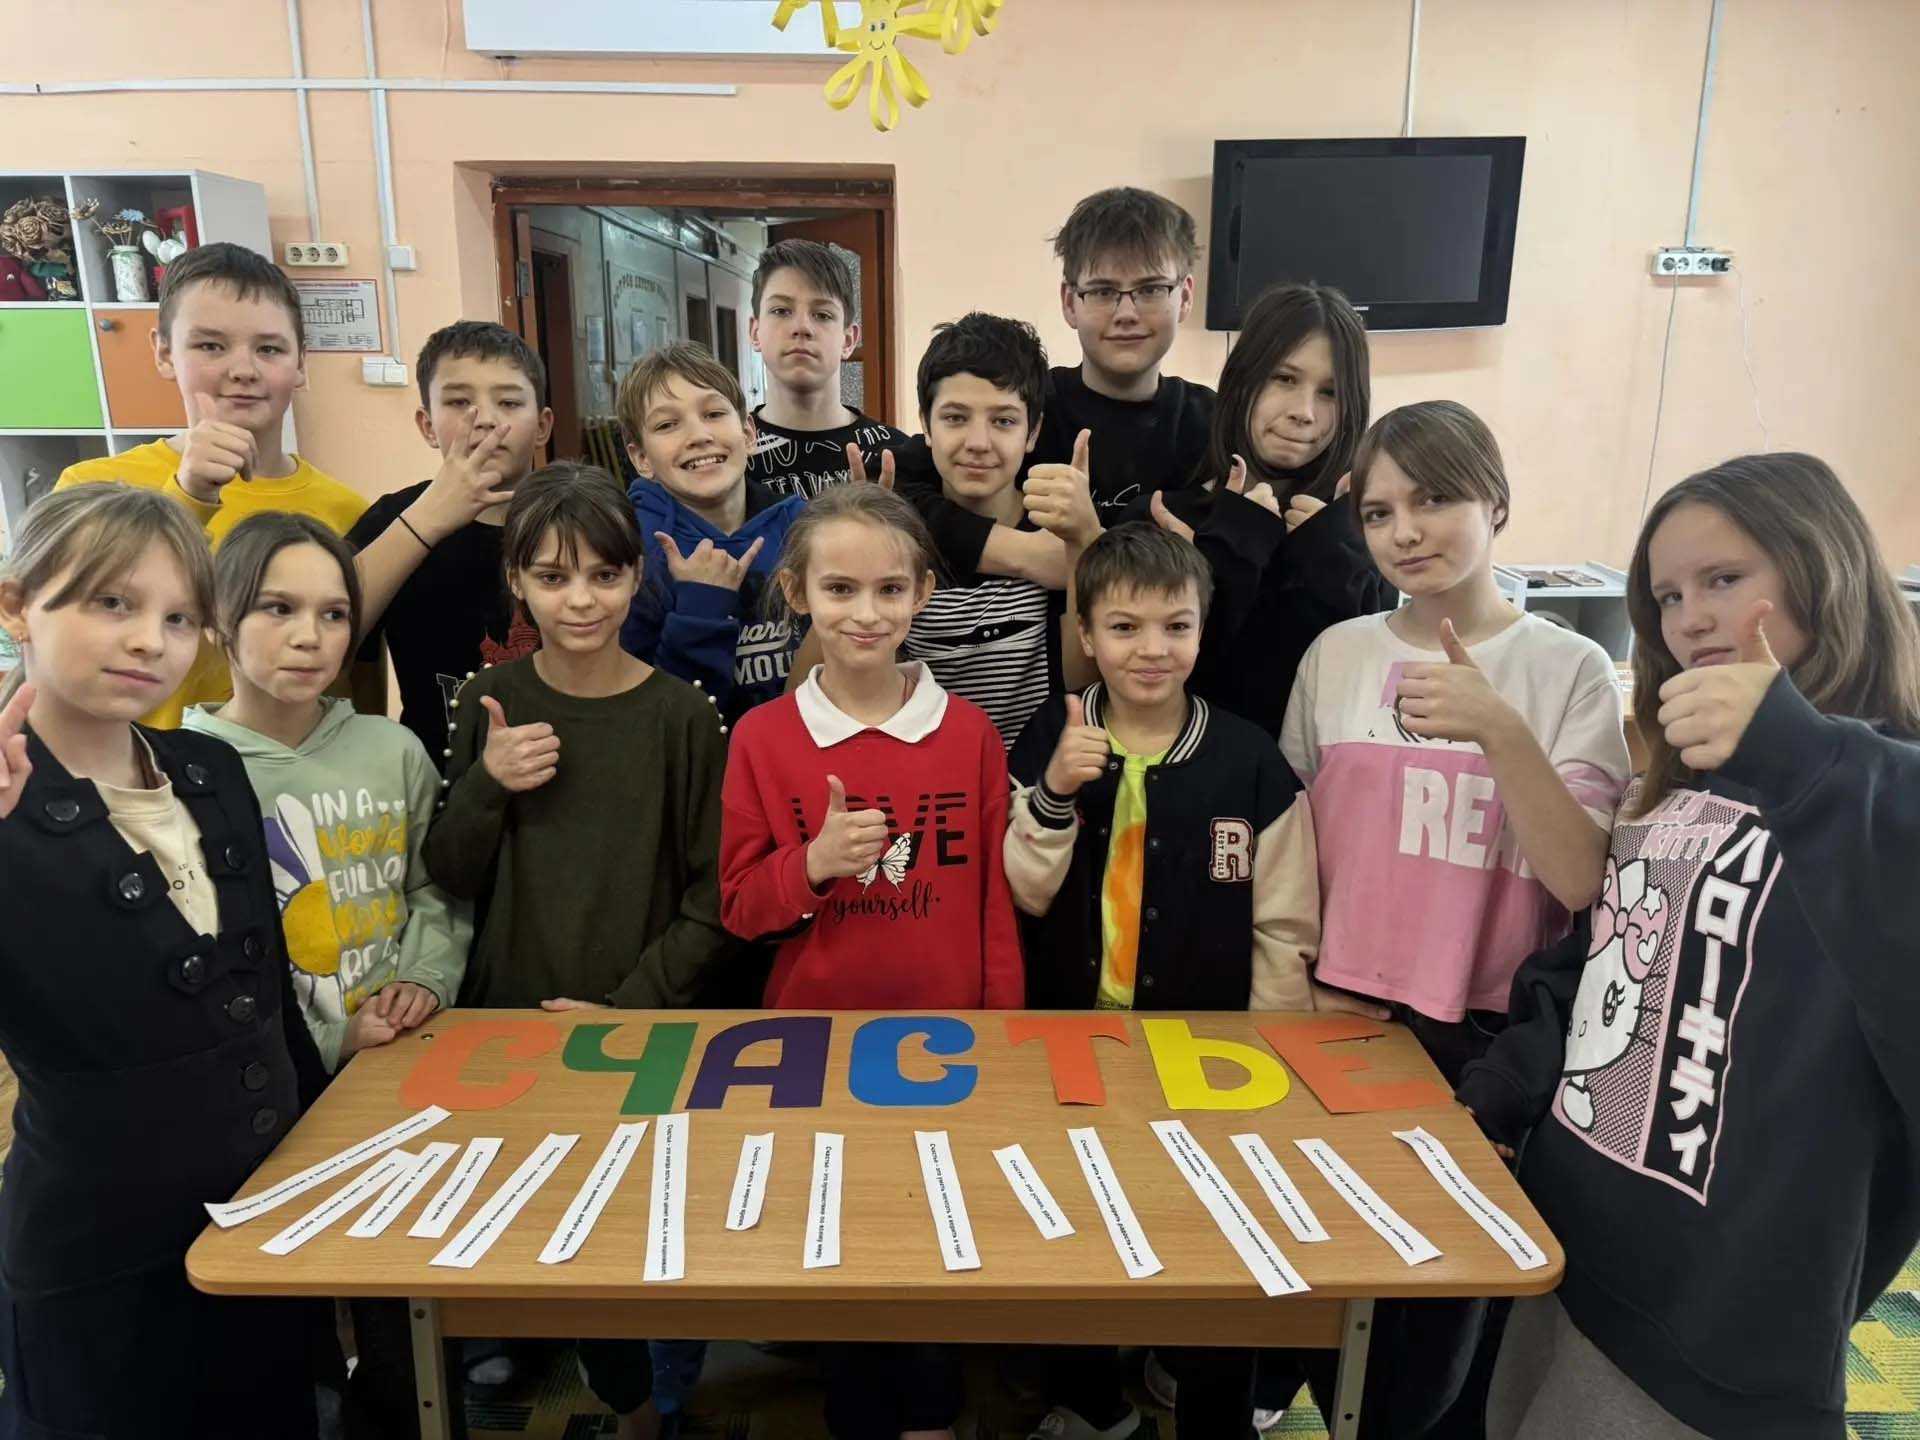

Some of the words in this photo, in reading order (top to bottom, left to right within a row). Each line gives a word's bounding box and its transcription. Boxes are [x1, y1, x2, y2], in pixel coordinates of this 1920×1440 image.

[312, 789, 348, 826] IN
[1639, 824, 1738, 862] KITTY
[400, 1016, 1456, 1115] СЧАСТЬЕ
